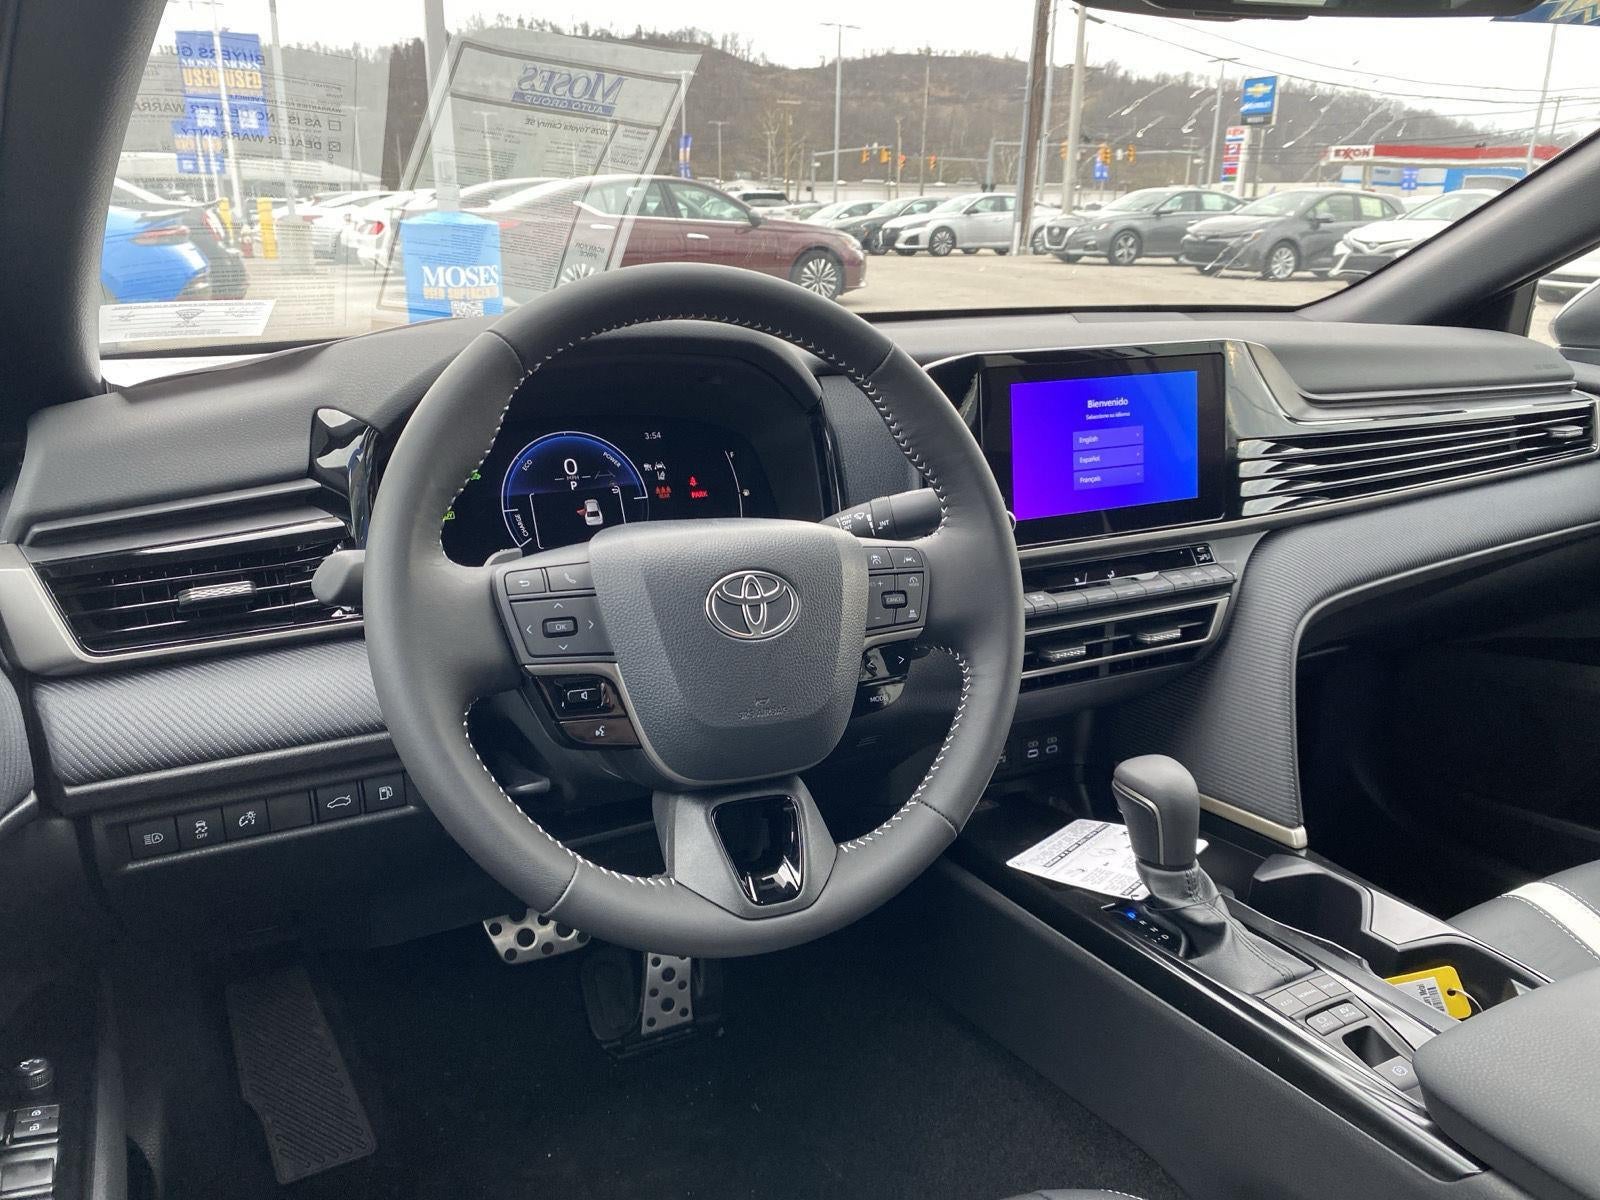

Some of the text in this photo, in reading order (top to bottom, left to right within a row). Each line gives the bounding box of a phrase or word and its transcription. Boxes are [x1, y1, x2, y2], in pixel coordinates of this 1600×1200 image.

[1334, 148, 1370, 159] EXXON
[422, 265, 498, 288] MOSES
[1087, 397, 1129, 409] Bienvenido
[644, 431, 661, 440] 3:54
[1079, 435, 1099, 444] English
[522, 459, 533, 471] ECO
[602, 452, 621, 468] POWER
[563, 458, 577, 475] 0
[570, 481, 577, 490] P
[515, 513, 529, 537] CHARGE
[880, 519, 889, 527] INT
[196, 832, 208, 840] OFF
